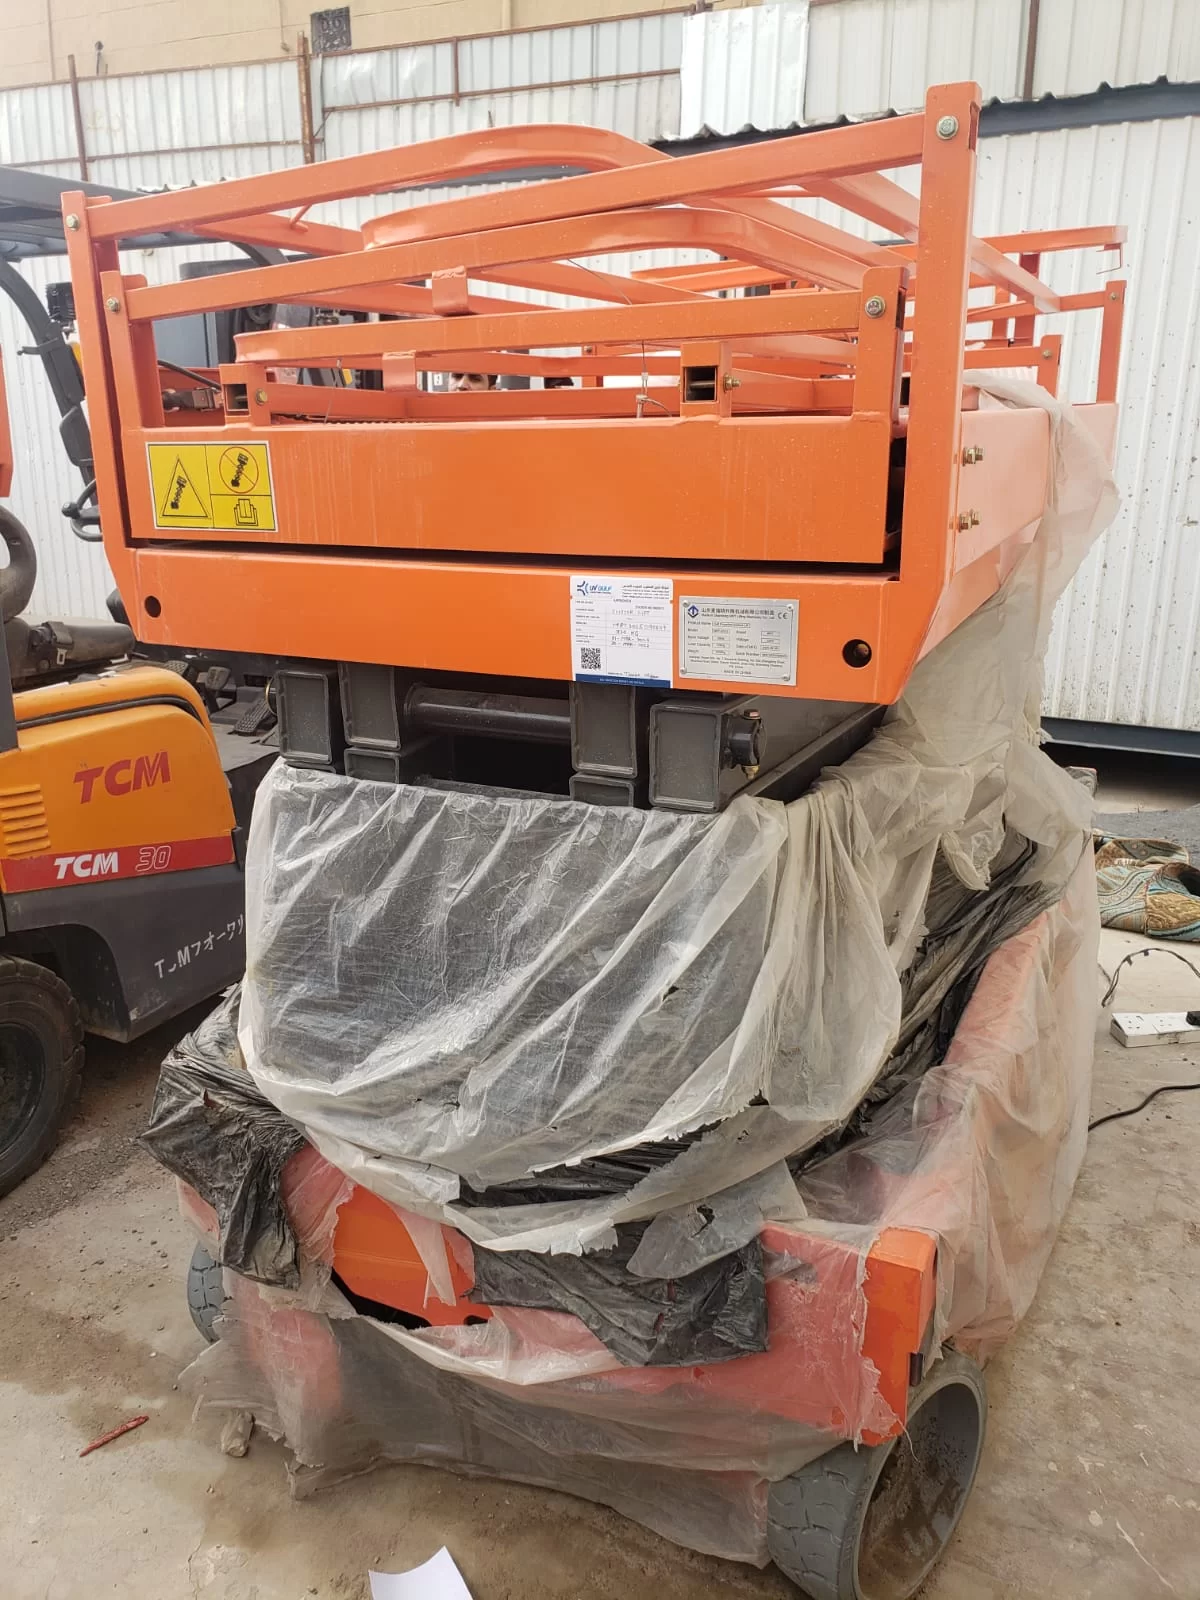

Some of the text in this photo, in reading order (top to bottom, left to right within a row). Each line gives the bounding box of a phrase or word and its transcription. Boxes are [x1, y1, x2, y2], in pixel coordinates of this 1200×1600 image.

[73, 751, 171, 804] TCM
[53, 845, 172, 880] TCM 30
